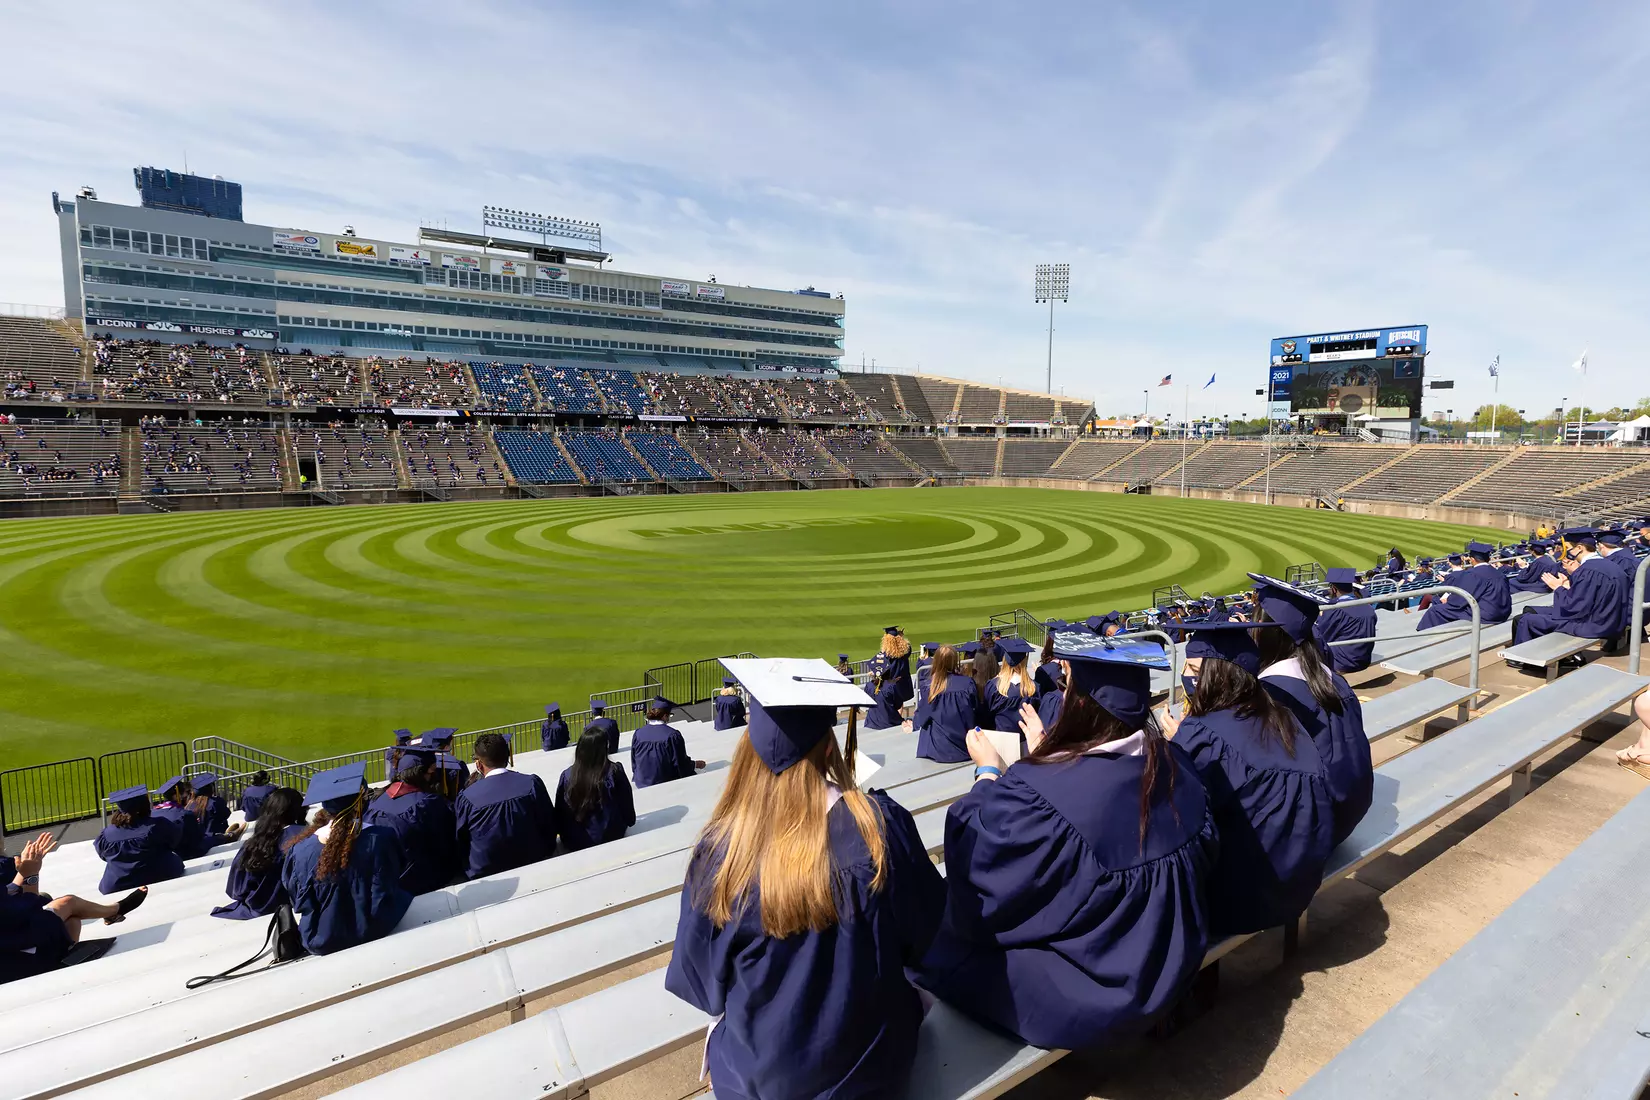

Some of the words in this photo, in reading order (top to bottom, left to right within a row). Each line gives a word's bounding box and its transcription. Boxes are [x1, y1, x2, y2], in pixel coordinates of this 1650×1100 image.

[96, 318, 137, 329] UCONN
[190, 326, 236, 336] HUSKIES
[1306, 336, 1324, 344] PRATT
[1330, 333, 1354, 343] WHITNEY
[1355, 330, 1381, 340] STADIUM
[1272, 371, 1290, 380] 2021
